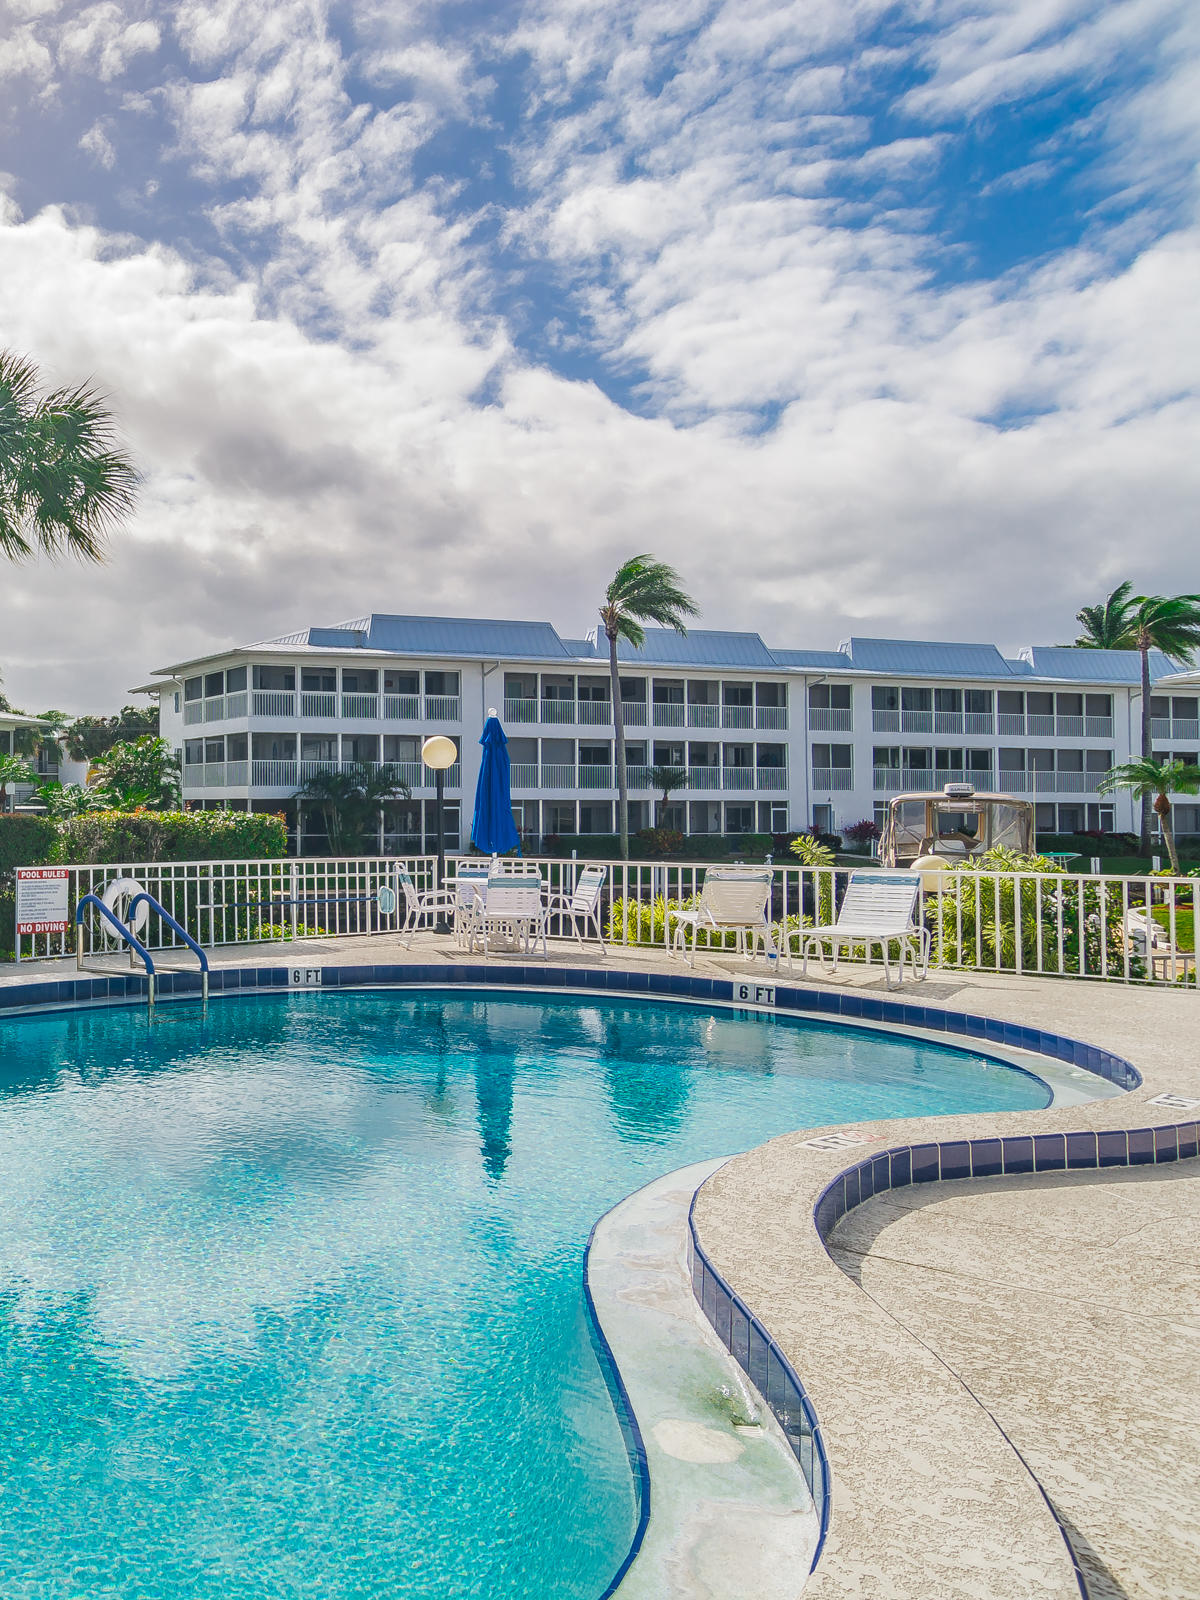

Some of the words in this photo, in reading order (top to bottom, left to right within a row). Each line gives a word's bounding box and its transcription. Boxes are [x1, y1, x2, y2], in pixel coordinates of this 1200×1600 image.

[21, 870, 40, 878] POOL
[42, 870, 66, 878] RULES
[20, 923, 33, 933] NO
[35, 922, 65, 932] DIVING
[293, 969, 301, 983] 6
[739, 985, 749, 999] 6
